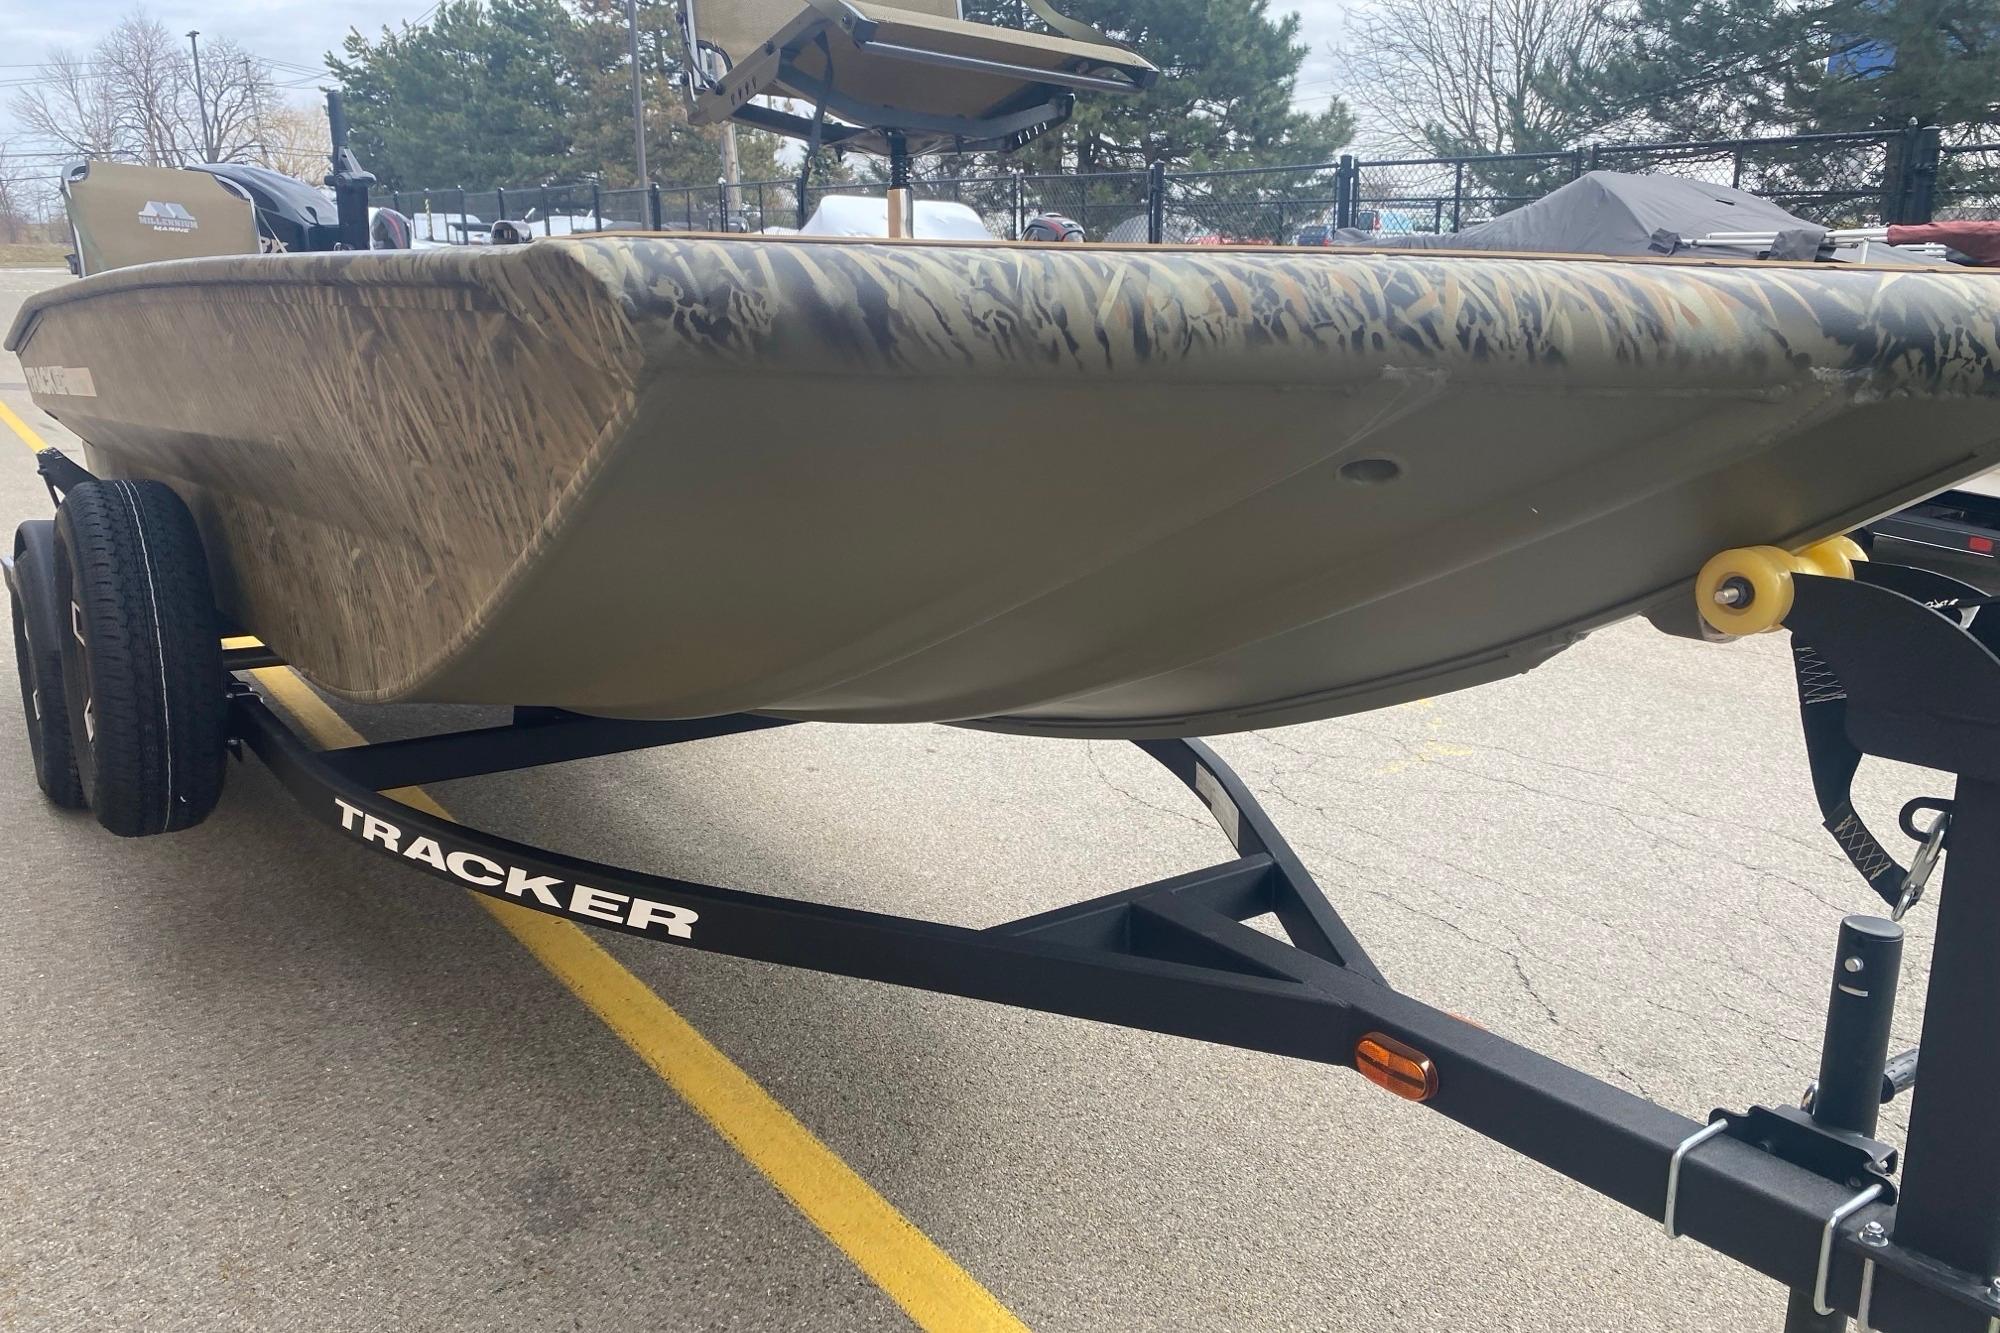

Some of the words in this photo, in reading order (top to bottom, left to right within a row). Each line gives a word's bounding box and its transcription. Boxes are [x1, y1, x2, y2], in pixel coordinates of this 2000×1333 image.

[138, 215, 199, 229] MILLENNIUM
[153, 225, 190, 233] MARINE
[335, 797, 700, 940] TRACKER
